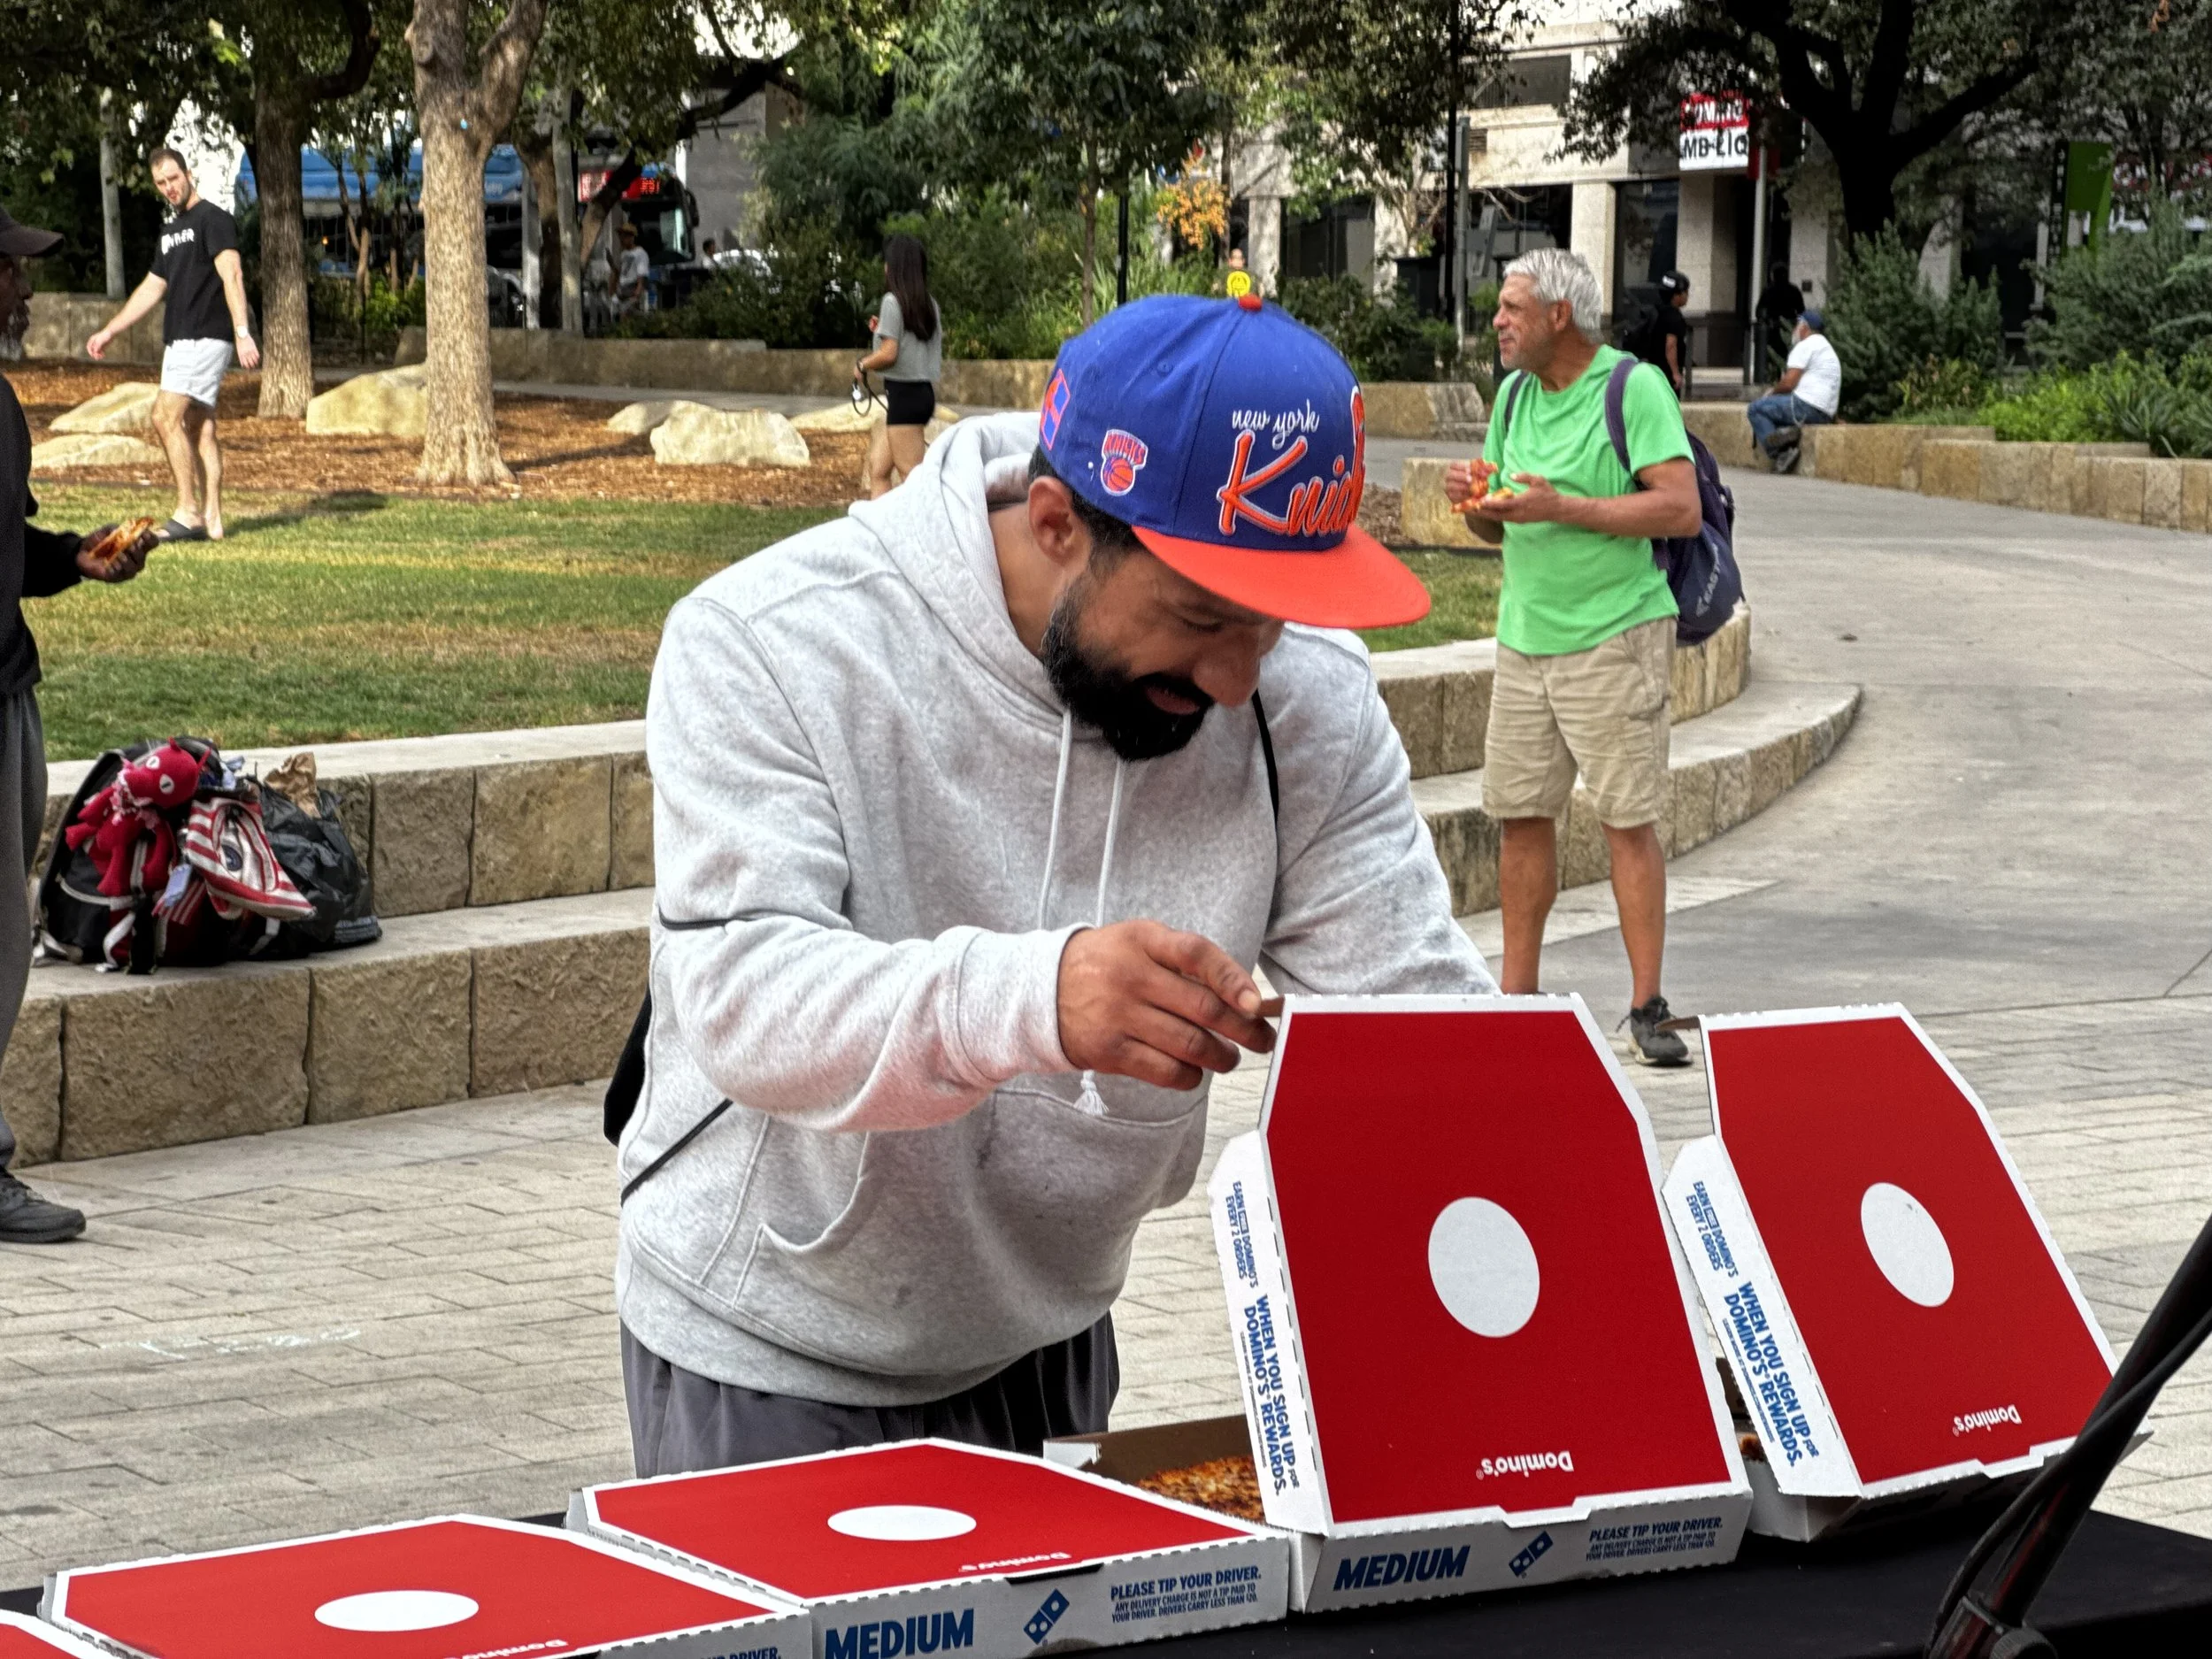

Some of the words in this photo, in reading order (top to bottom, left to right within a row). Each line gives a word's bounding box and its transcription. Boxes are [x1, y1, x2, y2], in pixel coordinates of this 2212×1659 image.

[1232, 410, 1271, 430] new
[1271, 398, 1319, 449] york
[1233, 1180, 1245, 1209] EARN
[1686, 1194, 1706, 1224] EVERY
[1693, 1180, 1711, 1207] EARN
[1225, 1195, 1239, 1226] EVERY
[1233, 1238, 1248, 1279] ORDERS
[1698, 1225, 1709, 1233] 2
[1701, 1233, 1724, 1271] ORDERS
[1256, 1294, 1276, 1350] WHEN
[1266, 1352, 1283, 1391] YOU
[1738, 1281, 1770, 1333] WHEN
[1759, 1333, 1785, 1370] YOU
[1773, 1371, 1801, 1413] SIGN
[1791, 1413, 1811, 1438] UP
[1272, 1393, 1291, 1439] SIGN
[1758, 1380, 1802, 1467] REWARDS.
[1261, 1402, 1286, 1496] REWARDS.
[1281, 1440, 1295, 1466] UP
[1480, 1450, 1574, 1479] Domino's
[1589, 1526, 1631, 1542] PLEASE
[1632, 1525, 1649, 1537] TIP
[1652, 1520, 1680, 1535] YOUR
[1682, 1516, 1723, 1532] DRIVER.
[1110, 1579, 1155, 1601] PLEASE
[1157, 1578, 1177, 1594] TIP
[1179, 1572, 1212, 1590] YOUR
[1216, 1565, 1261, 1585] DRIVER.
[1333, 1545, 1471, 1591] MEDIUM
[1111, 1612, 1130, 1624] YOUR
[1158, 1603, 1187, 1617] DRIVERS
[1187, 1601, 1209, 1611] CARRY
[1210, 1597, 1225, 1609] LESS
[1227, 1594, 1245, 1606] THAN
[1115, 1601, 1129, 1611] ANY
[1131, 1596, 1161, 1610] DELIVERY
[1162, 1594, 1188, 1606] CHARGE
[1190, 1591, 1196, 1601] IS
[1198, 1589, 1211, 1600] NOT
[1219, 1586, 1229, 1597] TIP
[1231, 1584, 1245, 1595] PAID
[1247, 1582, 1256, 1593] TO
[825, 1608, 974, 1659] MEDIUM
